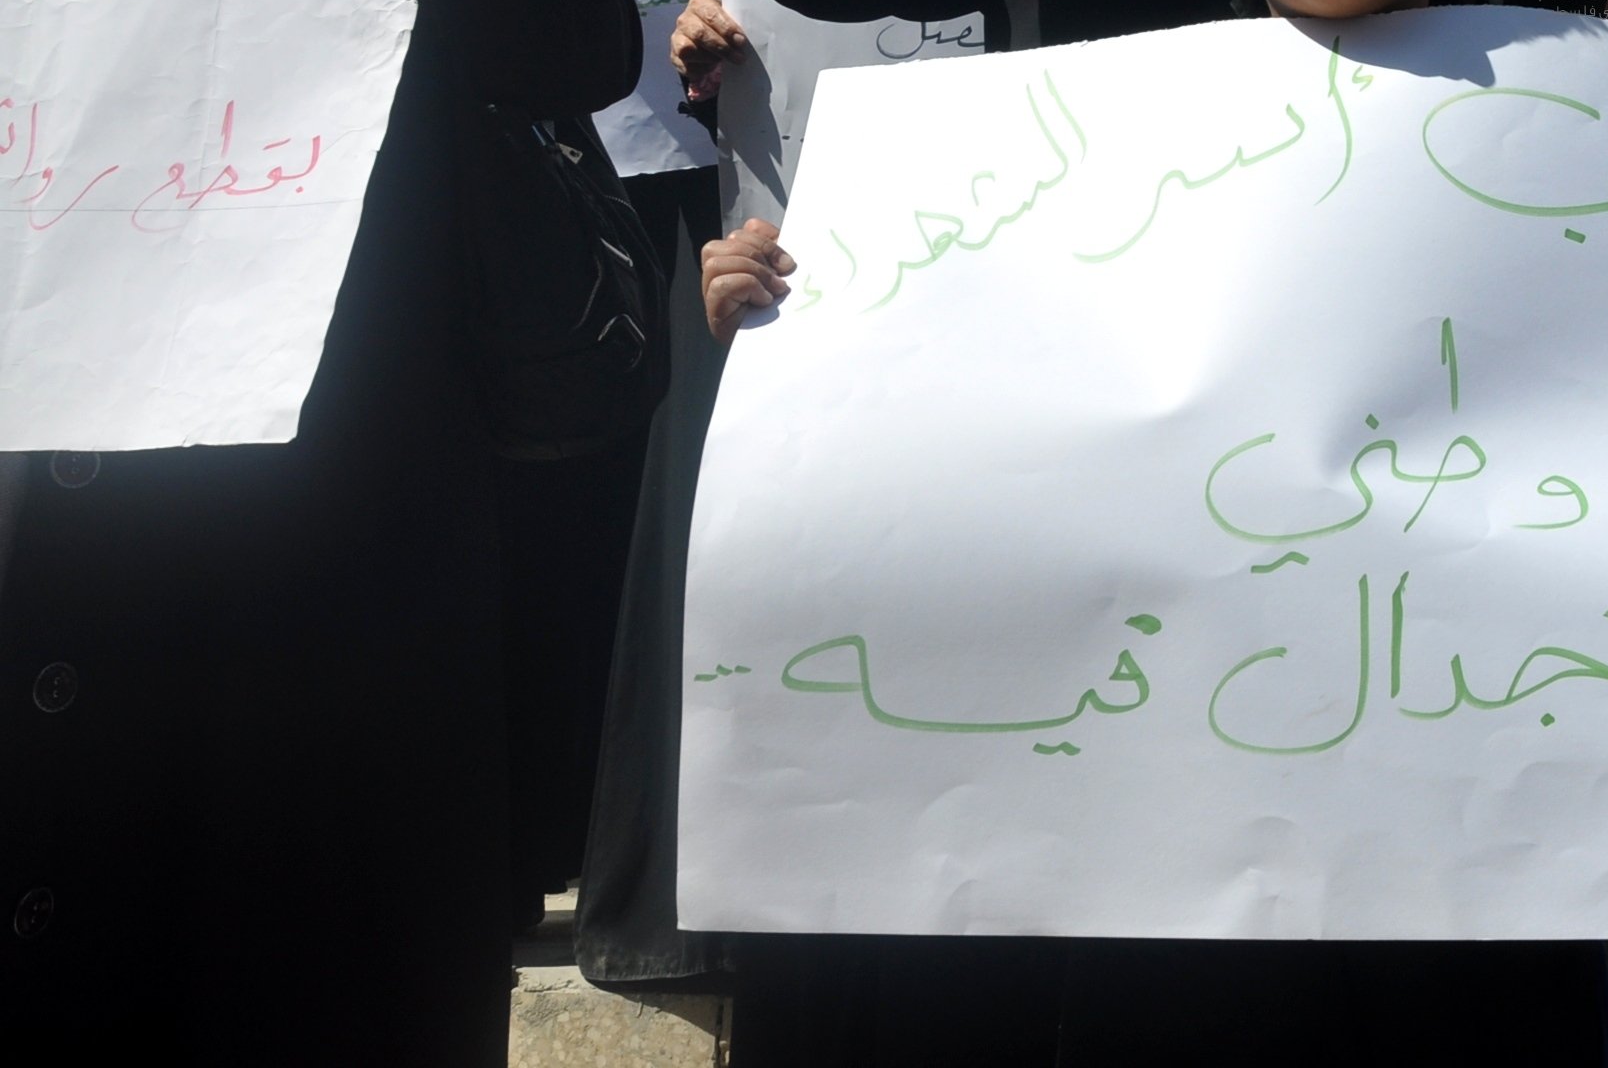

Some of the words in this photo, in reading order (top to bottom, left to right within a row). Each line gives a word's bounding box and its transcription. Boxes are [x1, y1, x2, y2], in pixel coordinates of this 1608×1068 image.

[131, 100, 322, 233] بقطع
[1072, 36, 1374, 264] أسر
[781, 613, 1163, 757] فيه
